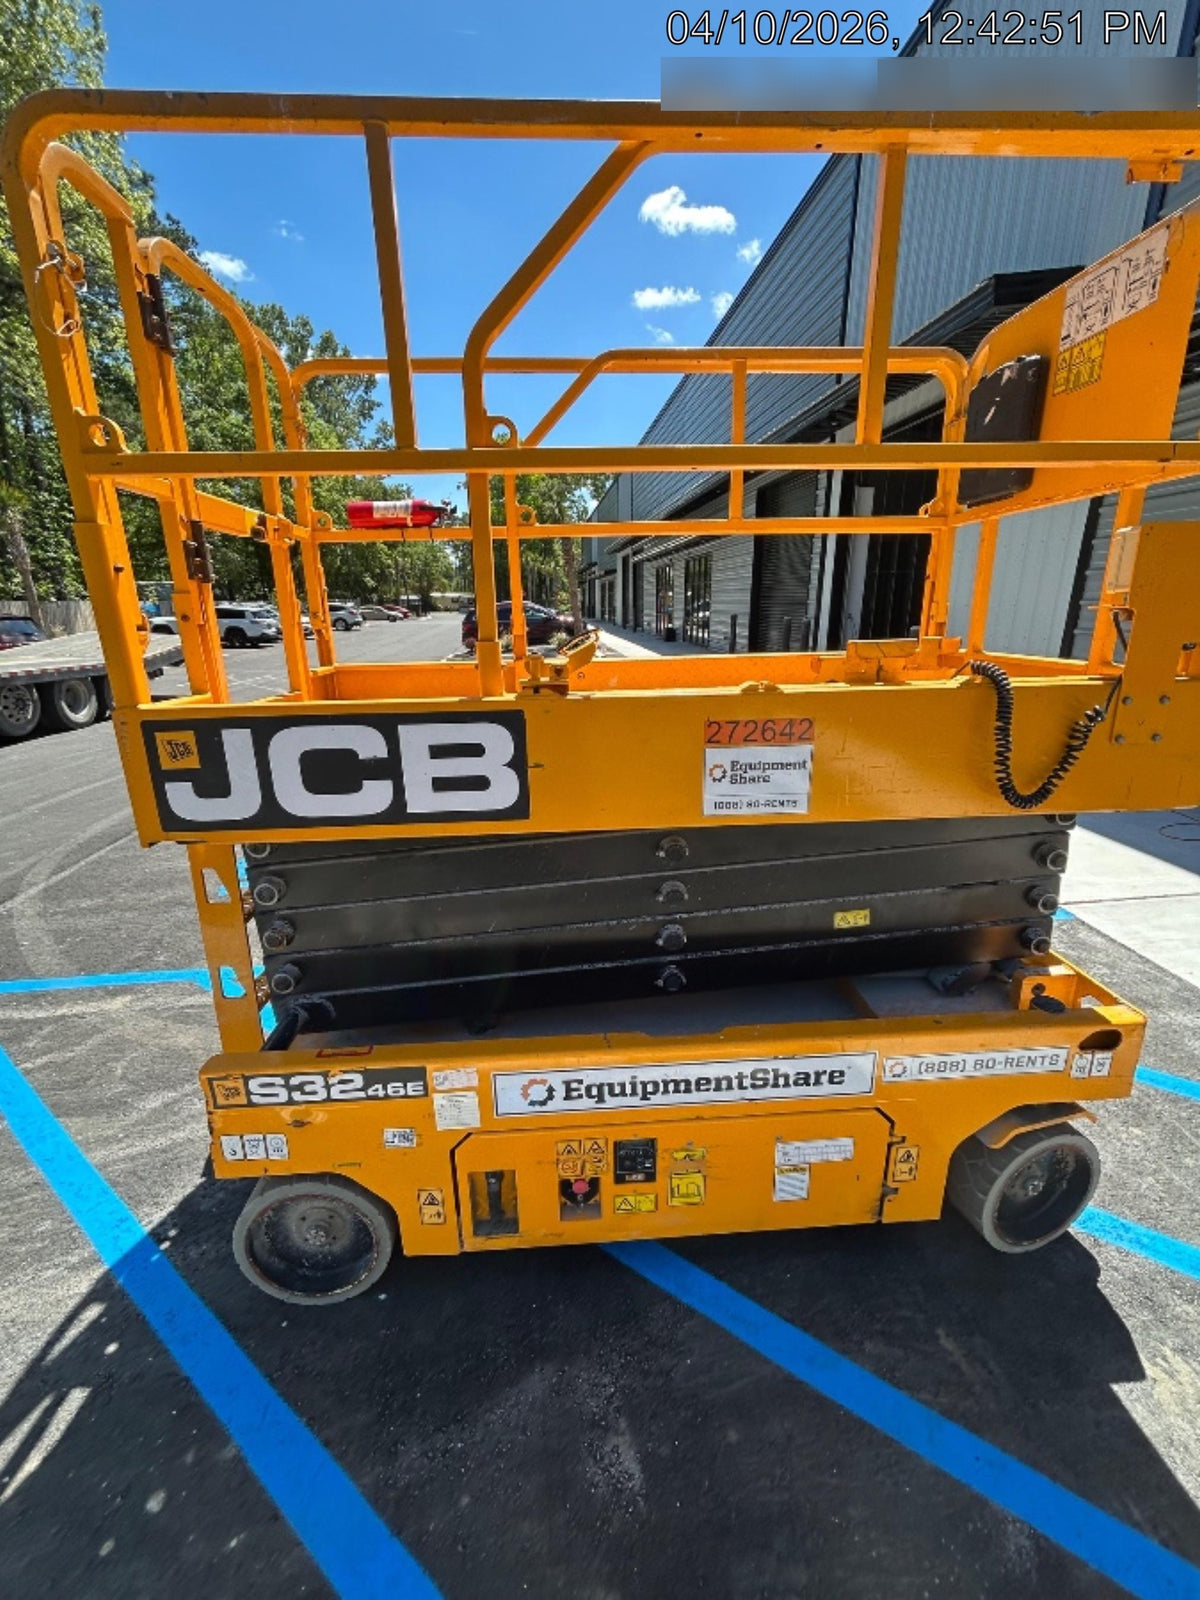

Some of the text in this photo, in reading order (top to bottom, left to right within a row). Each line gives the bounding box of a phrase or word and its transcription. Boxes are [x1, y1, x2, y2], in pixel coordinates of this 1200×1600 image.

[706, 718, 813, 744] 272642
[164, 722, 520, 822] JCB
[730, 760, 808, 774] Equipment
[730, 774, 771, 785] Share
[248, 1073, 424, 1104] S32 46E
[562, 1066, 847, 1102] EquipmentShare
